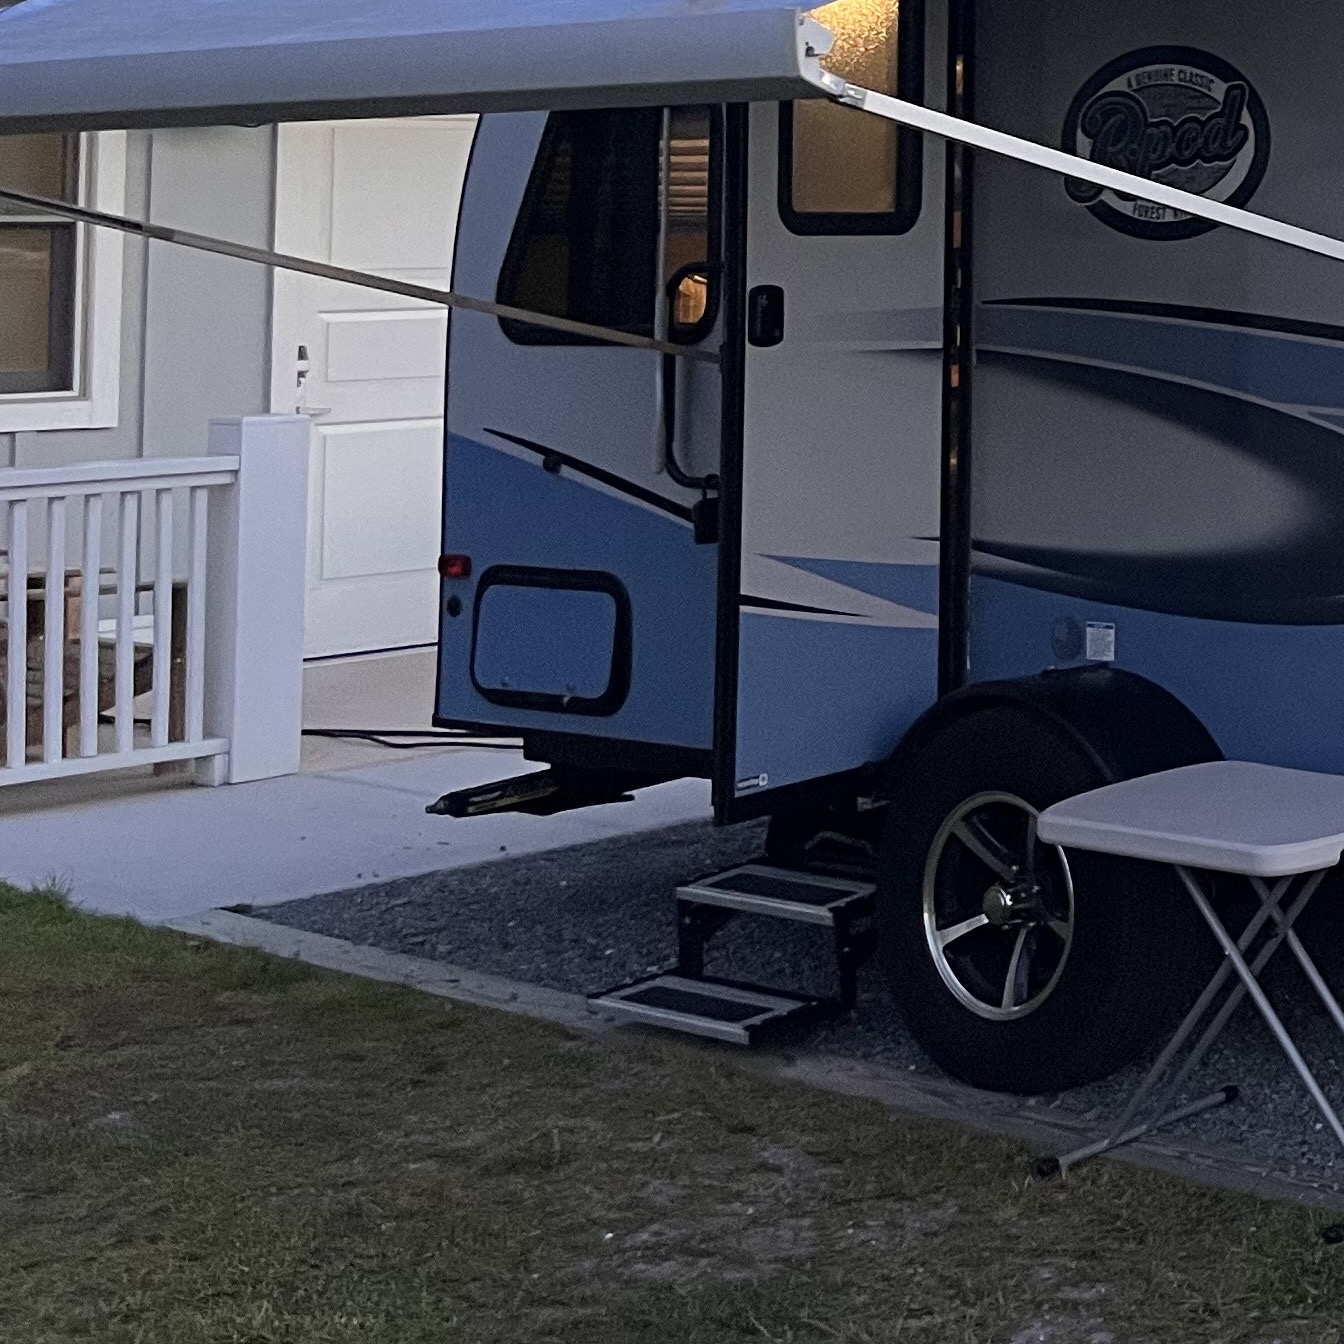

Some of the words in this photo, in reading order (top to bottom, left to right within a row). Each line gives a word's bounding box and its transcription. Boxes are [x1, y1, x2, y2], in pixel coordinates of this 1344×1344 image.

[1135, 68, 1175, 87] GENUINE
[1177, 68, 1216, 92] CLASSIC
[1132, 201, 1167, 221] FOREST
